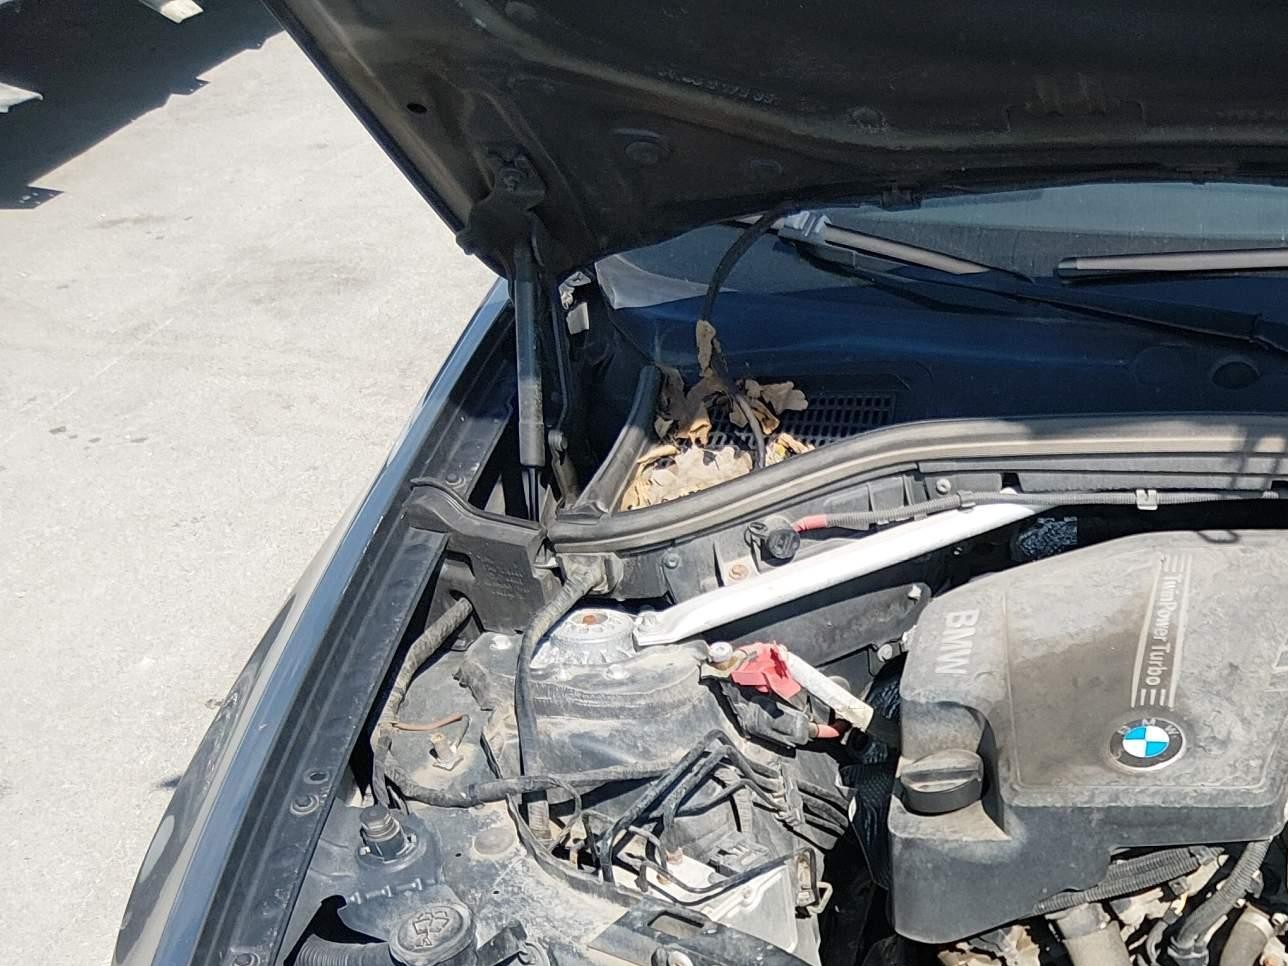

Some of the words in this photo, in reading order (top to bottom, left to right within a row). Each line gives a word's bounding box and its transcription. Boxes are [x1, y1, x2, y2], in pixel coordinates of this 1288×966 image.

[1153, 574, 1182, 642] TwinPower
[936, 609, 980, 675] BMW
[1145, 642, 1171, 686] Turbo
